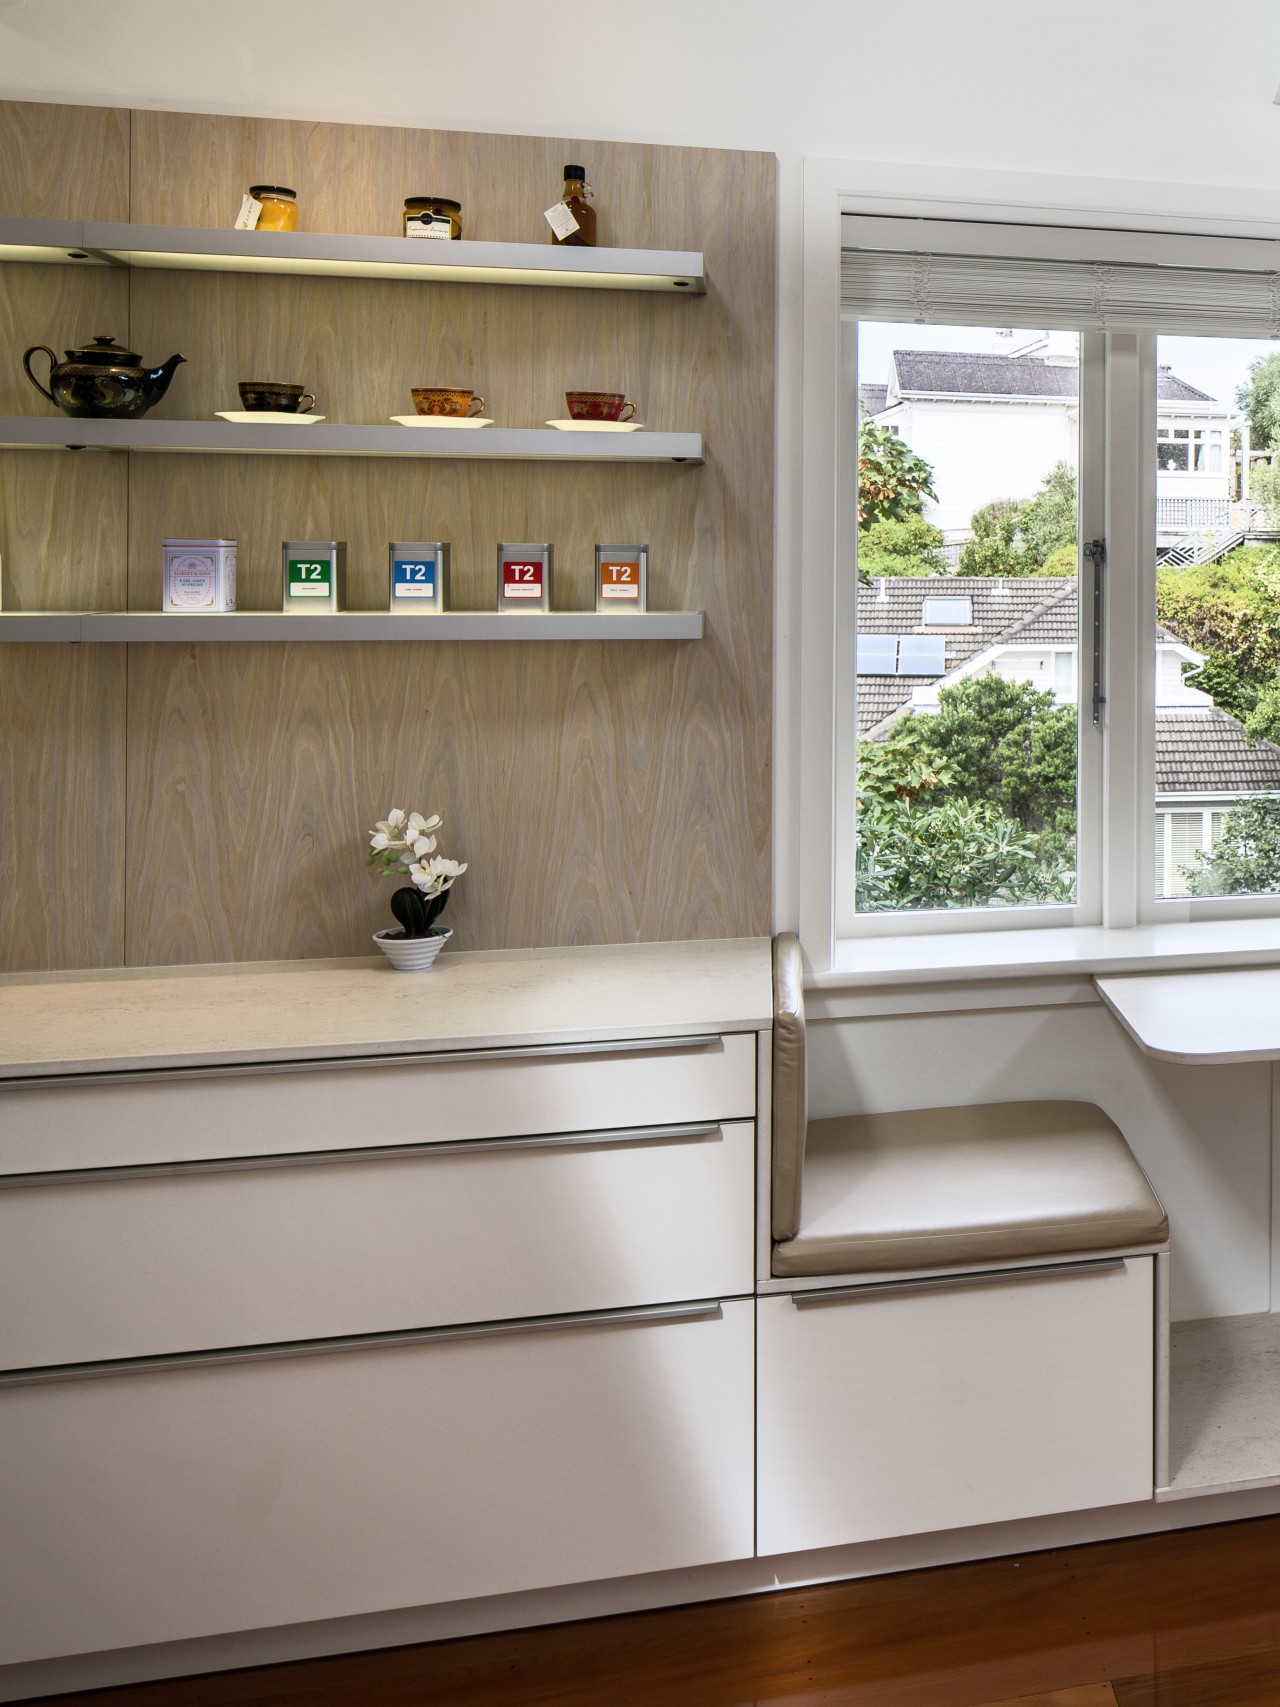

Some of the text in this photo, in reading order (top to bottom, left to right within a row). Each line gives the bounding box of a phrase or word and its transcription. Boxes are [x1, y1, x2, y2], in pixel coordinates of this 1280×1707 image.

[297, 564, 322, 579] T2
[402, 565, 426, 580] T2
[511, 566, 534, 581] T2
[608, 566, 631, 581] T2
